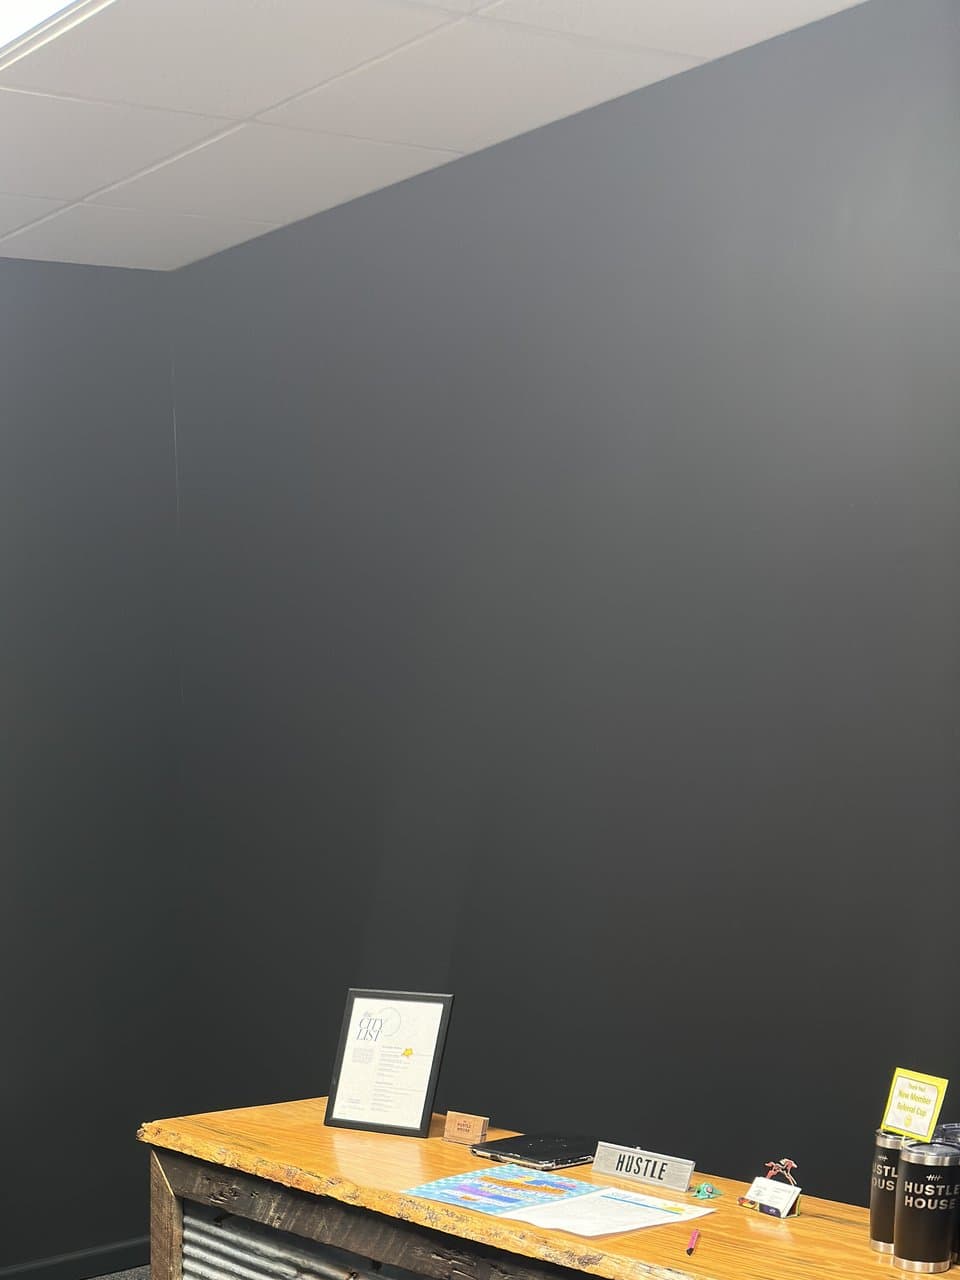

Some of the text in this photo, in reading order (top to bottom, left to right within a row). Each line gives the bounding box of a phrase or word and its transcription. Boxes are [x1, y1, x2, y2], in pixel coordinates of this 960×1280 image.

[359, 1017, 384, 1030] CITY
[357, 1029, 382, 1042] LIST
[898, 1088, 932, 1105] New Member
[916, 1108, 927, 1117] Cup
[616, 1154, 668, 1180] HUSTLE
[904, 1181, 960, 1196] HUSTLE
[904, 1195, 957, 1210] HOUSE
